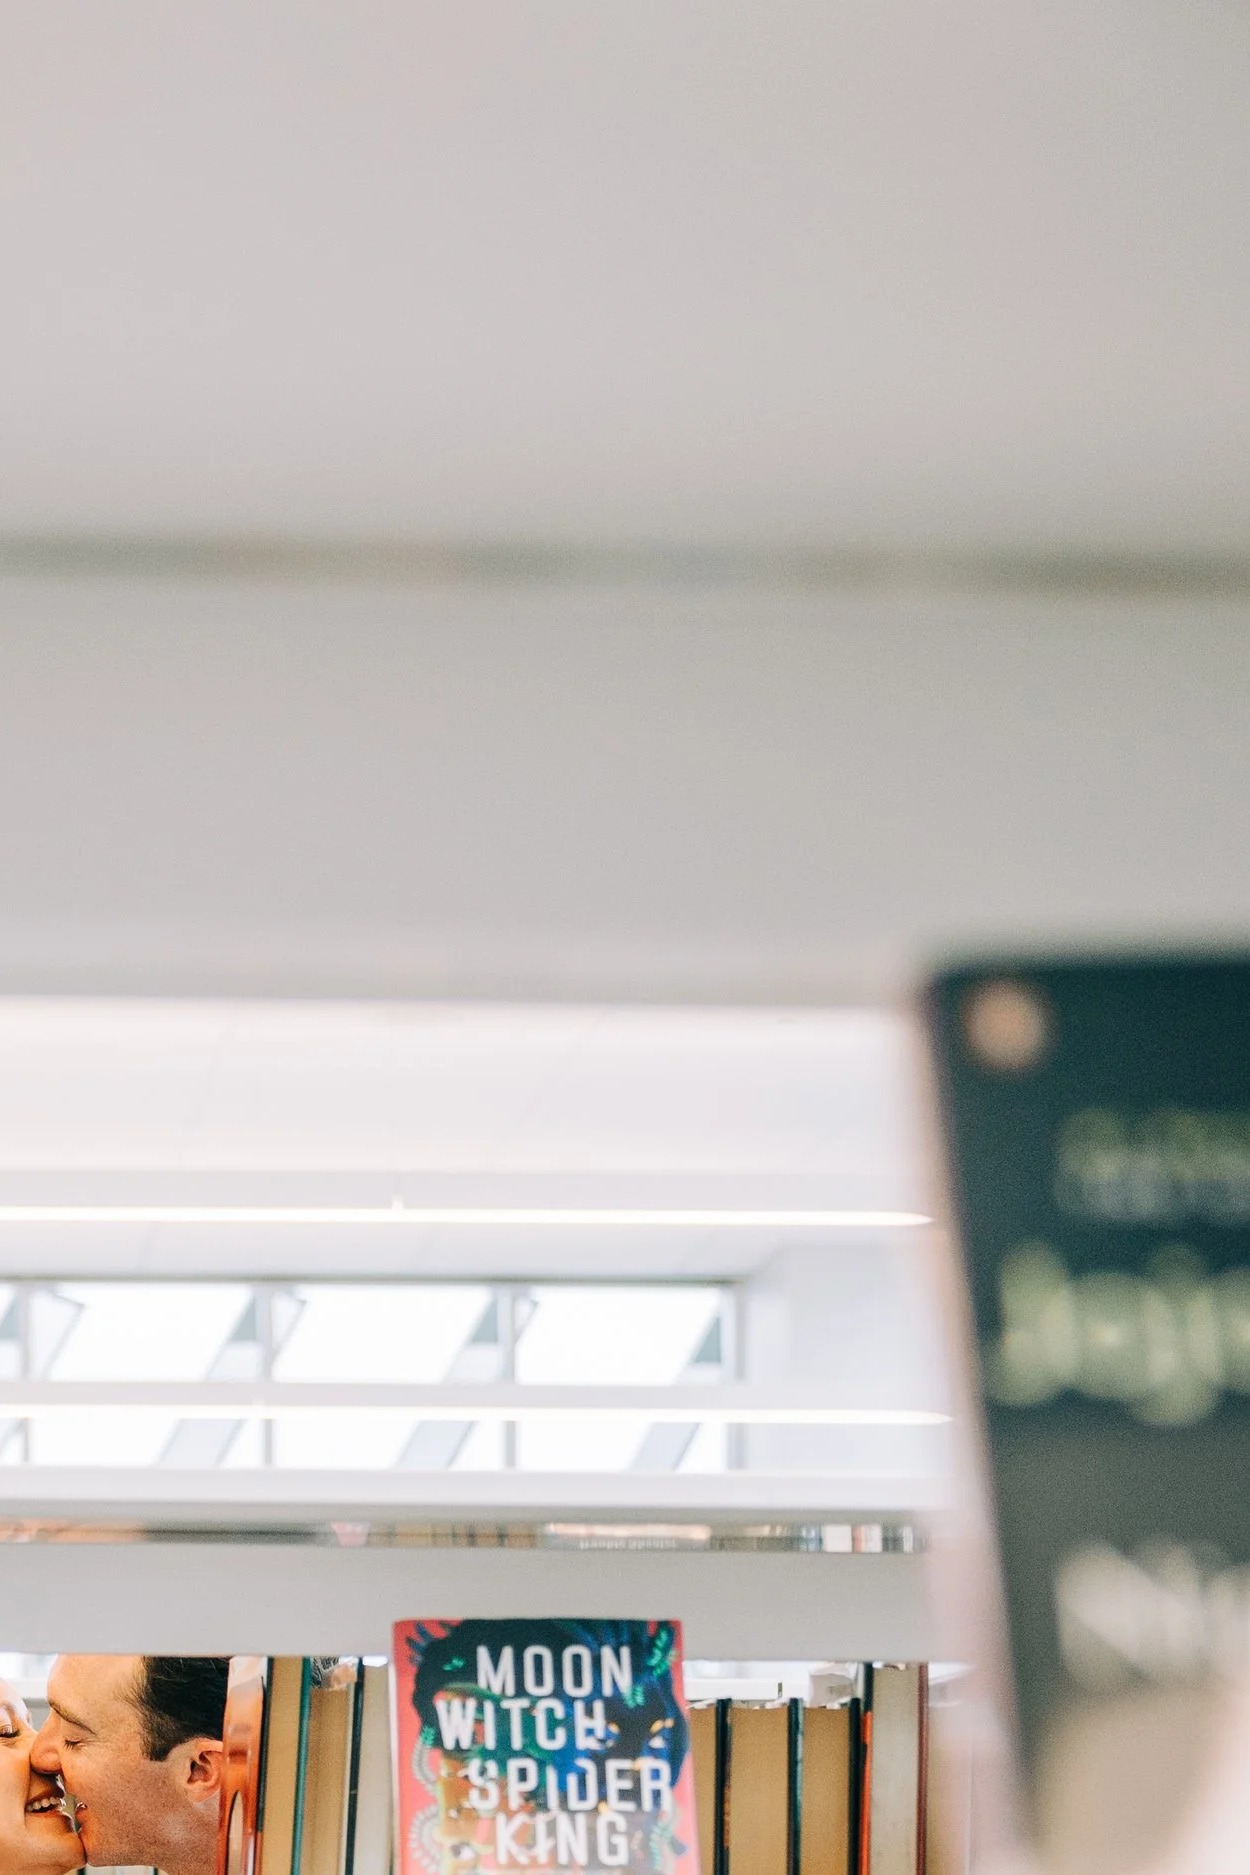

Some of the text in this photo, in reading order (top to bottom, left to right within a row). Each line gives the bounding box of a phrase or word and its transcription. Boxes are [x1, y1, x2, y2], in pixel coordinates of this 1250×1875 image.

[476, 1645, 632, 1697] MOON
[436, 1699, 607, 1751] WITCH
[467, 1758, 672, 1812] SPIDER
[495, 1812, 630, 1866] KING
